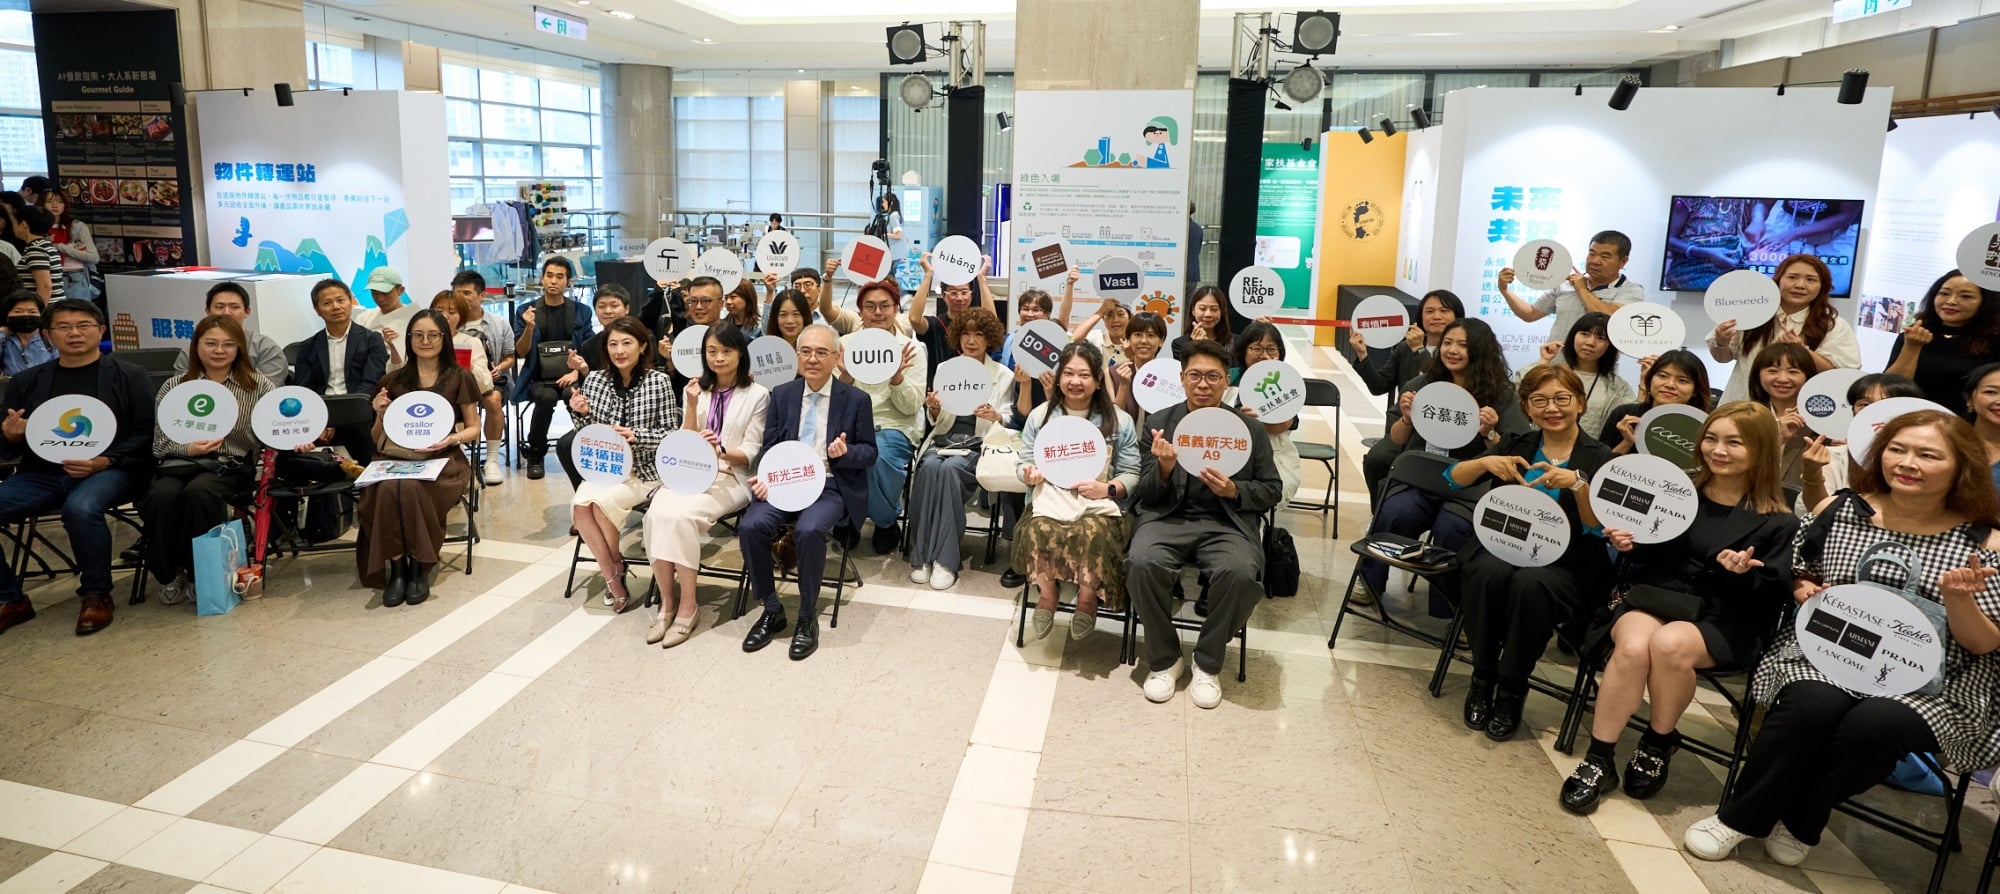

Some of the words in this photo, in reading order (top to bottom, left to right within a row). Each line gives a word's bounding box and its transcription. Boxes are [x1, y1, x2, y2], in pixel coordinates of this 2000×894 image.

[81, 85, 112, 94] Gourmet
[113, 85, 135, 94] Guide
[214, 162, 316, 183] 物件轉運站
[1103, 276, 1135, 288] Vast.
[1243, 277, 1263, 287] RE:
[1242, 287, 1274, 297] NROB
[1242, 295, 1264, 305] LAB
[1715, 295, 1769, 307] Blueseeds
[1023, 333, 1060, 362] gozo
[943, 379, 985, 391] rather
[1422, 404, 1468, 427] 谷慕慕
[404, 420, 434, 428] essilor
[40, 439, 99, 448] PADE
[581, 437, 624, 452] RE:ACTION
[1044, 440, 1096, 459] 新光三越
[1177, 434, 1248, 450] 信義新天地
[1202, 451, 1221, 461] A9
[580, 458, 624, 476] 生活展
[767, 463, 816, 484] 新光三越
[1654, 504, 1687, 521] PRADA
[1532, 531, 1561, 547] PRADA
[1881, 648, 1925, 672] PRADA
